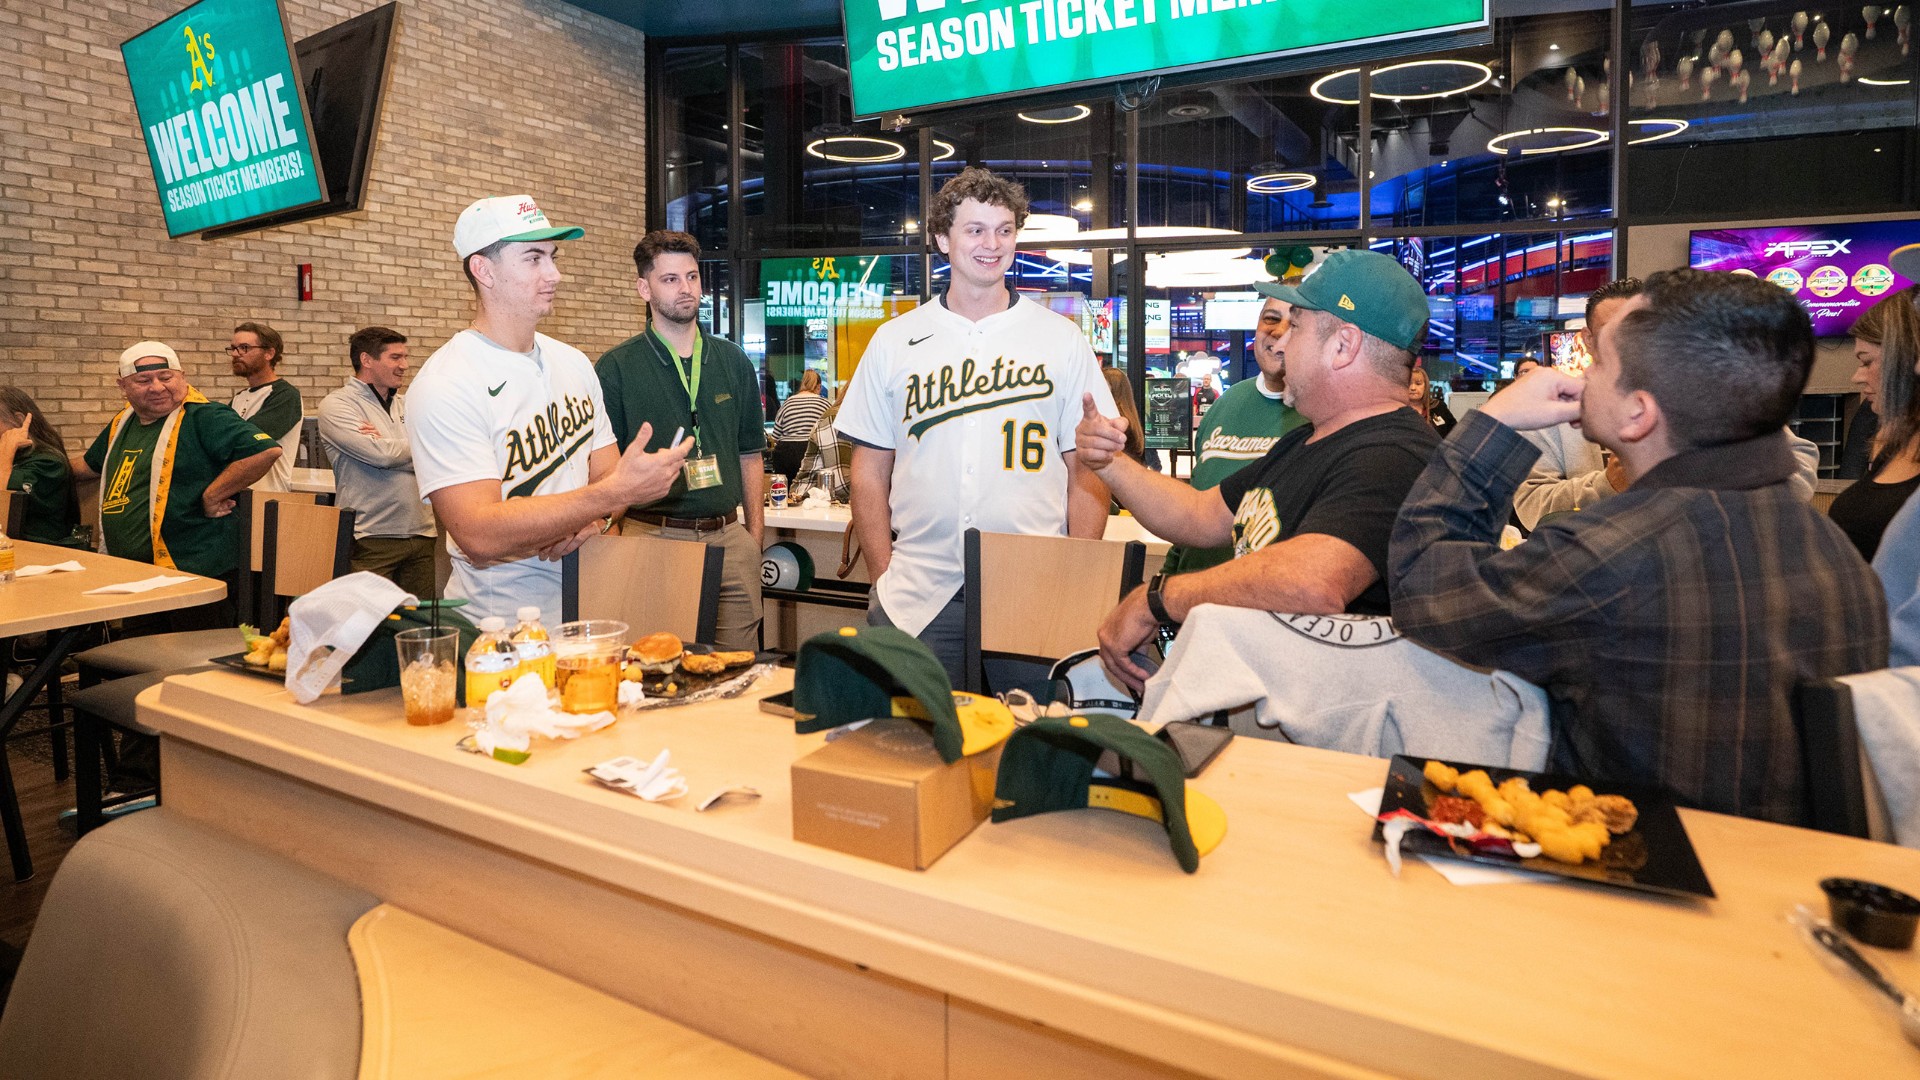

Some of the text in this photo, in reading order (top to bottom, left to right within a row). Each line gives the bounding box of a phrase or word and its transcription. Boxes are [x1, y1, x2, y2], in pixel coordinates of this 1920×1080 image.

[184, 25, 216, 94] A's
[875, 6, 1016, 72] SEASON
[149, 72, 298, 185] WELCOME
[166, 150, 305, 213] SEASON TICKET MEMBERS!
[1764, 239, 1852, 259] APEX
[902, 355, 1055, 425] Athletics
[1001, 417, 1049, 473] 16
[762, 565, 775, 580] 14
